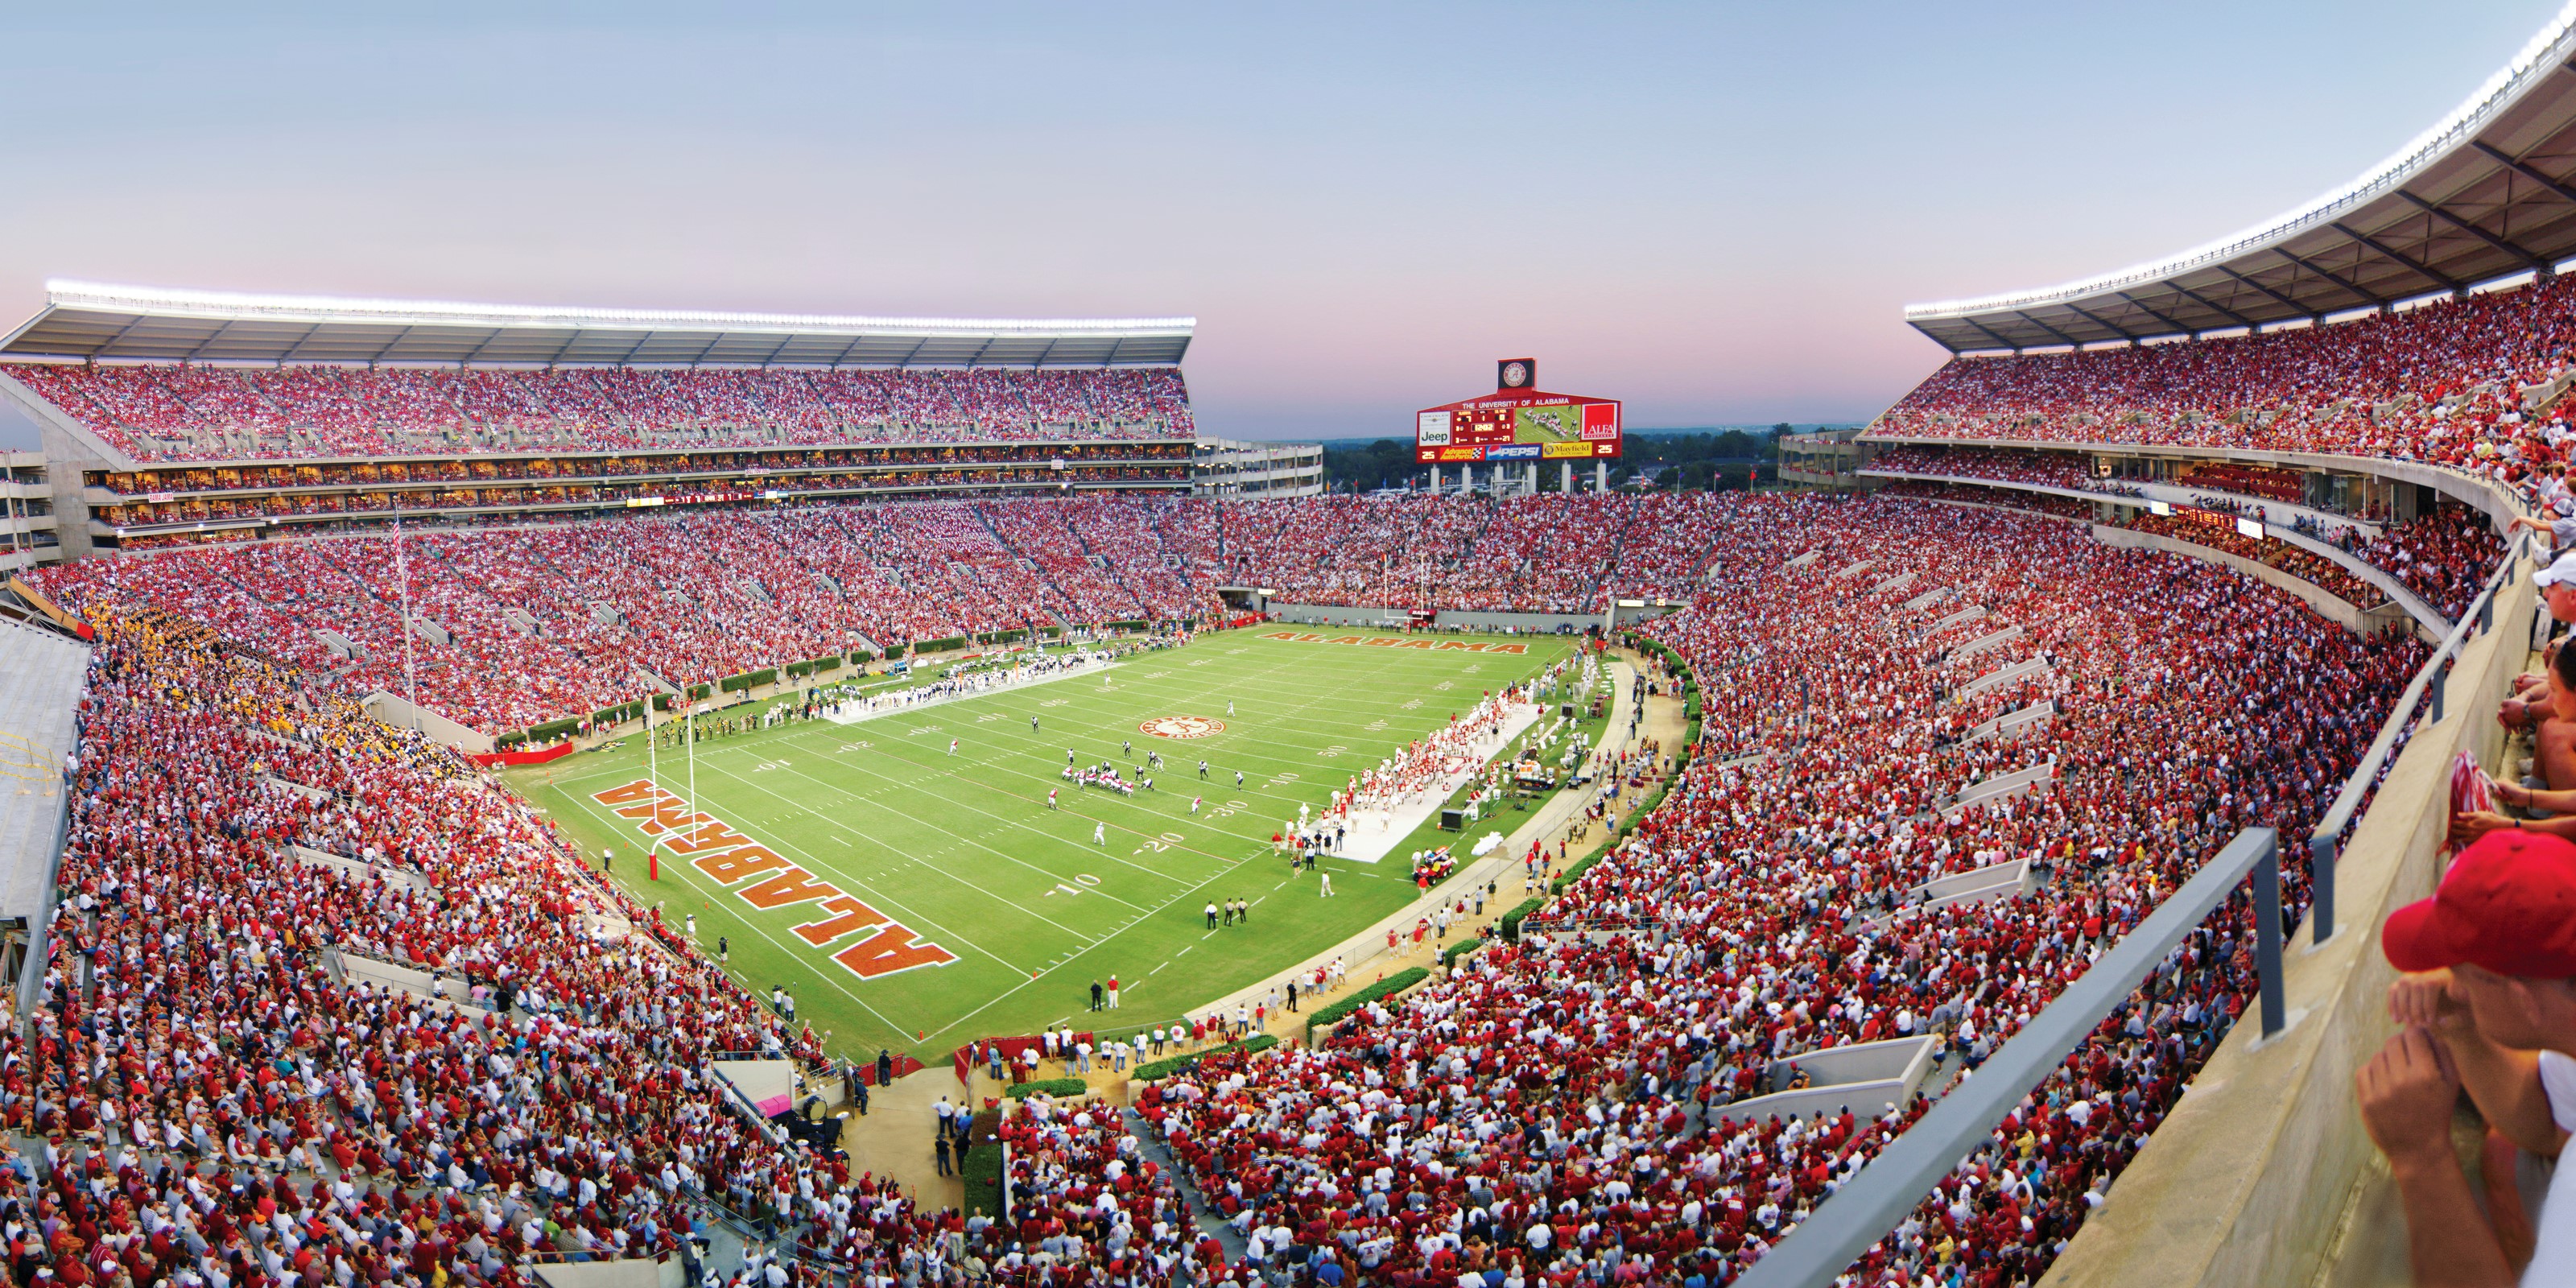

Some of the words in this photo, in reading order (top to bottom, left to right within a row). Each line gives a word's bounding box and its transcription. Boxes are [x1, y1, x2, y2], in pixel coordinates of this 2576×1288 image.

[1479, 401, 1517, 409] UNIVERSITY
[1534, 398, 1570, 406] ALABAMA
[1588, 424, 1615, 435] ALFA
[1422, 431, 1447, 443] Jeep
[1501, 447, 1539, 456] PEPSI
[1598, 444, 1612, 453] 25
[1422, 451, 1435, 460] 25
[1254, 631, 1530, 655] ALABAMA
[840, 741, 875, 751] 20
[1317, 745, 1348, 758] 50
[758, 759, 793, 770] 10
[1268, 772, 1301, 786] 40
[1212, 799, 1249, 817] 30
[1141, 832, 1187, 853] 20
[589, 778, 961, 980] ALABAMA
[1055, 873, 1102, 897] 10
[1500, 1160, 1510, 1172] 12
